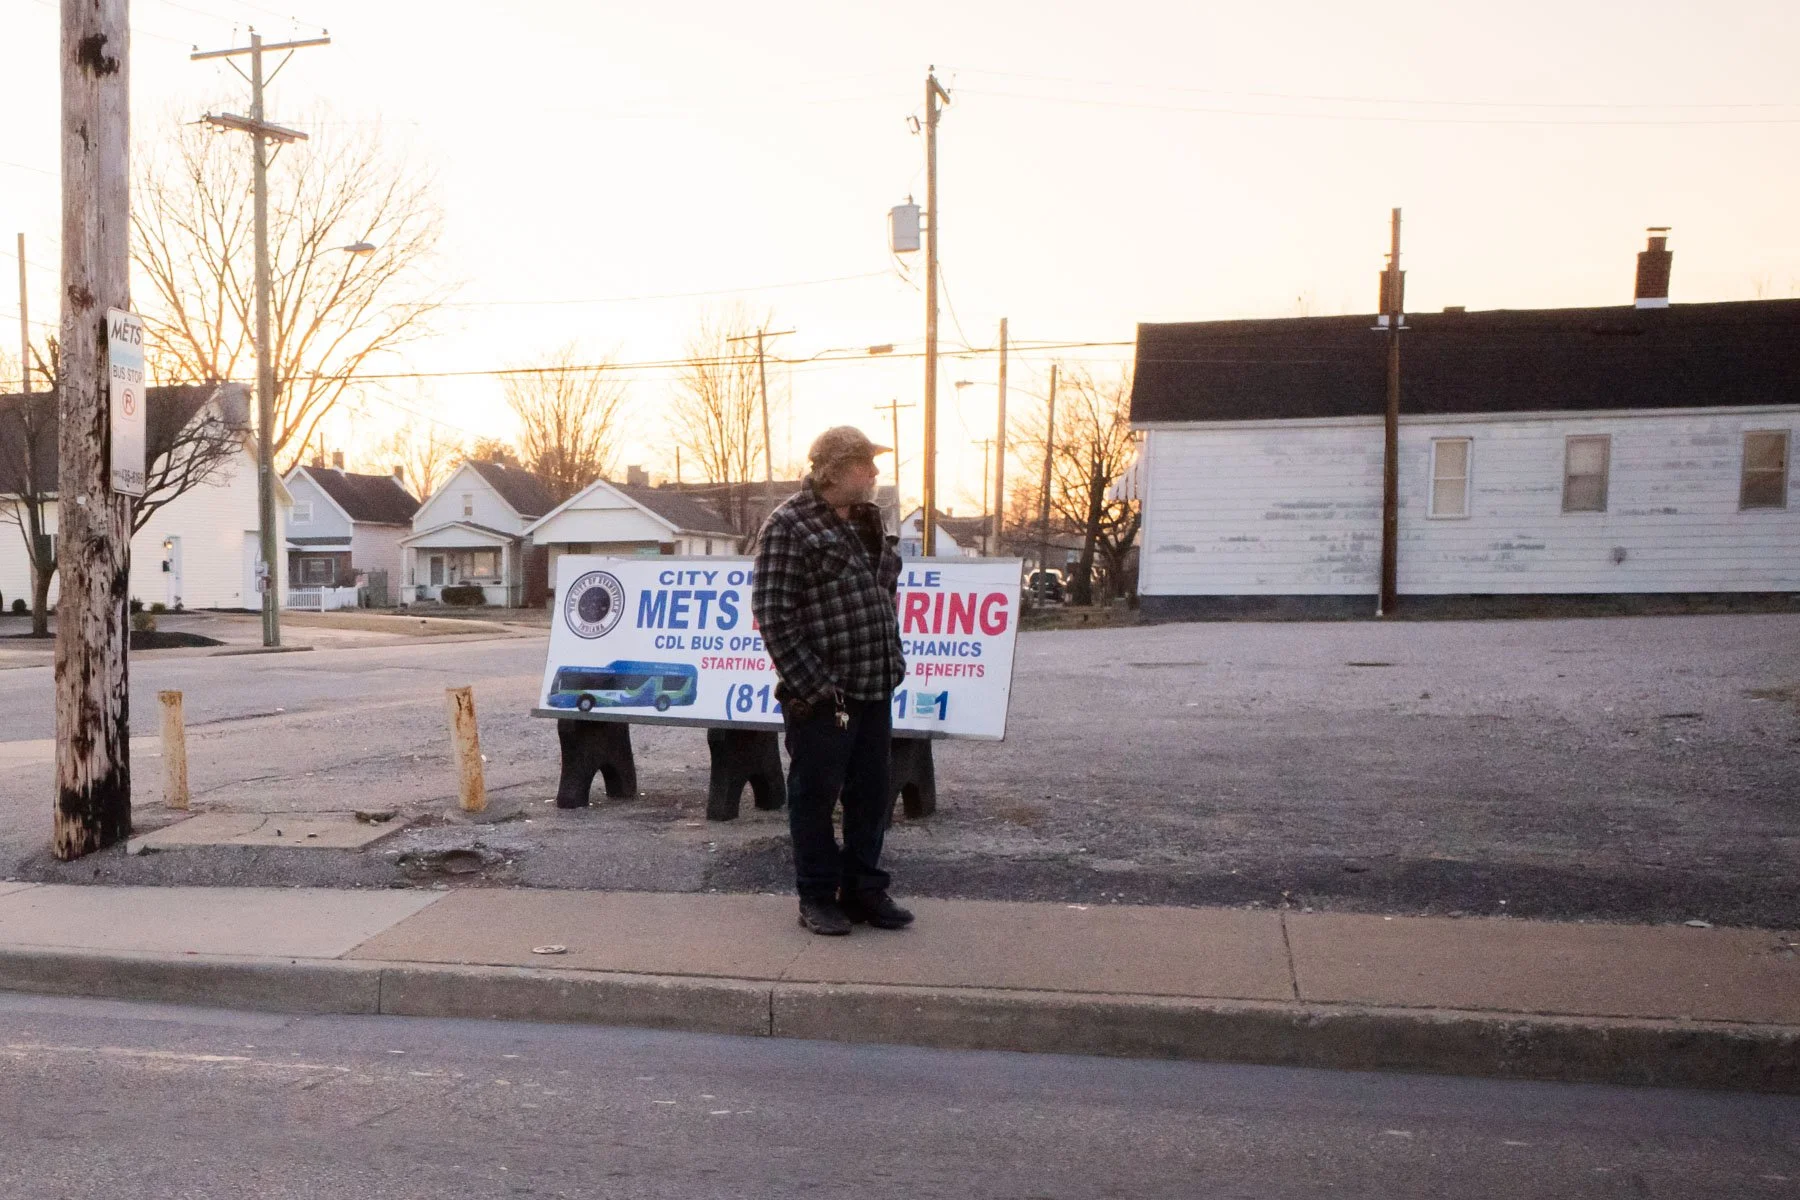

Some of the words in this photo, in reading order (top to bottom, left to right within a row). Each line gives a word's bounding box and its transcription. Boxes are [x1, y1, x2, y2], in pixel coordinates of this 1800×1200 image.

[111, 318, 142, 346] METS
[113, 365, 125, 380] BUS
[127, 368, 142, 384] STOP
[659, 571, 718, 586] CITY
[637, 590, 740, 631] METS
[655, 636, 684, 650] CDL
[691, 636, 724, 651] BUS
[701, 657, 765, 671] STARTING
[915, 662, 985, 678] BENEFITS
